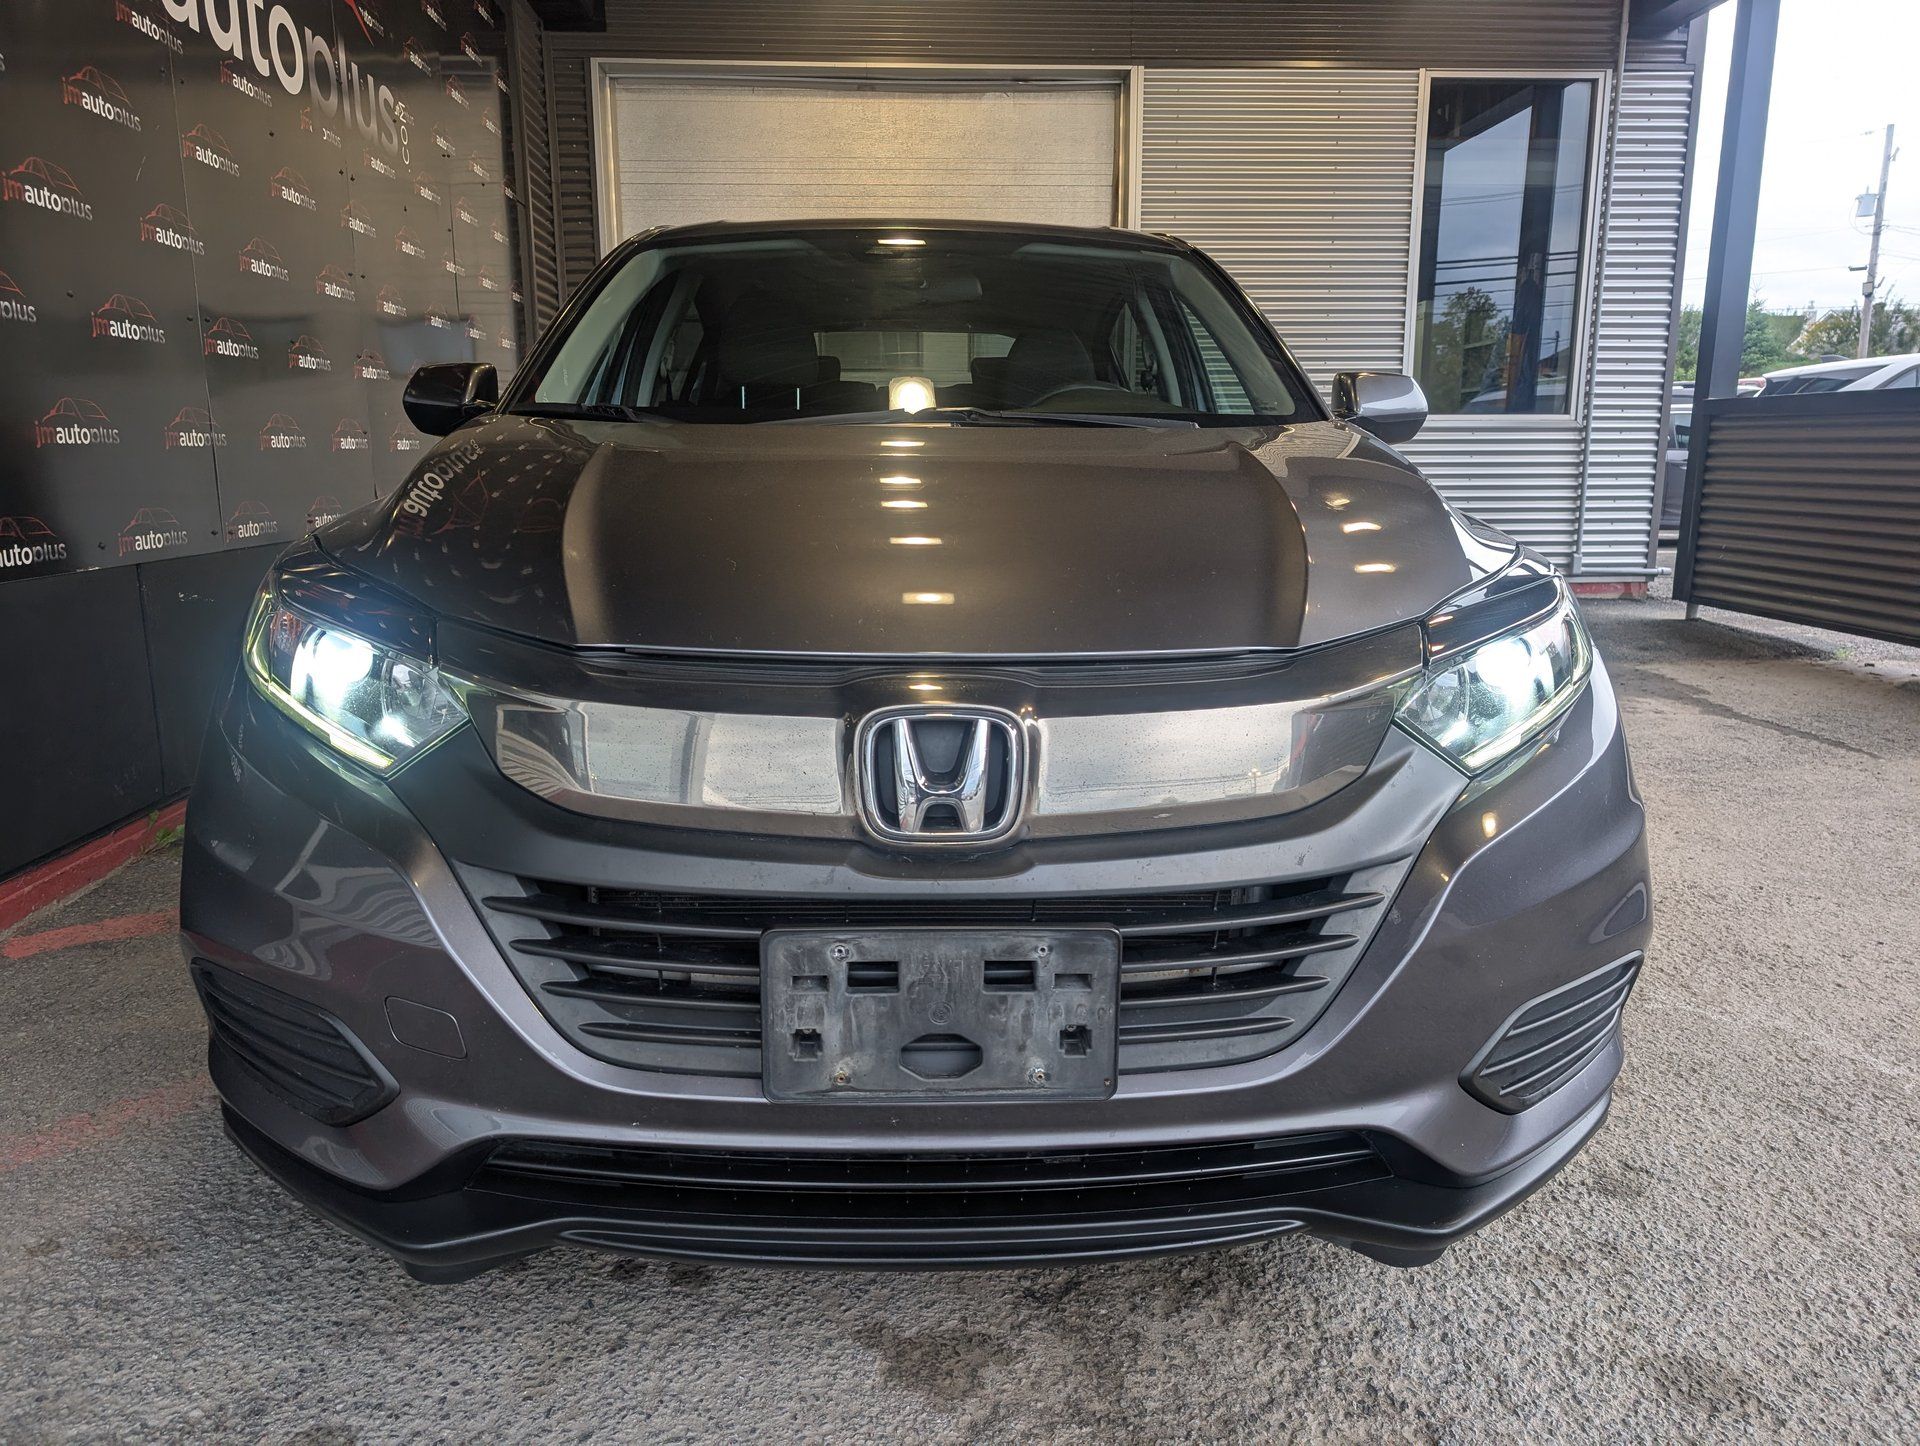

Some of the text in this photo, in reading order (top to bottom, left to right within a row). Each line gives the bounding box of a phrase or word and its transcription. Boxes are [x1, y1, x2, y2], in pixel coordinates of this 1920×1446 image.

[115, 0, 183, 55] jmautoplus
[62, 77, 141, 131] jmautoplus
[182, 134, 239, 177] jmautoplus
[2, 171, 92, 221] jmautoplus
[140, 217, 204, 255] jmautoplus
[239, 250, 289, 281] jmautoplus
[91, 311, 165, 343] jmautoplus
[204, 333, 258, 359] jmautoplus
[34, 421, 120, 448] jmautoplus
[118, 531, 188, 557] jmautoplus
